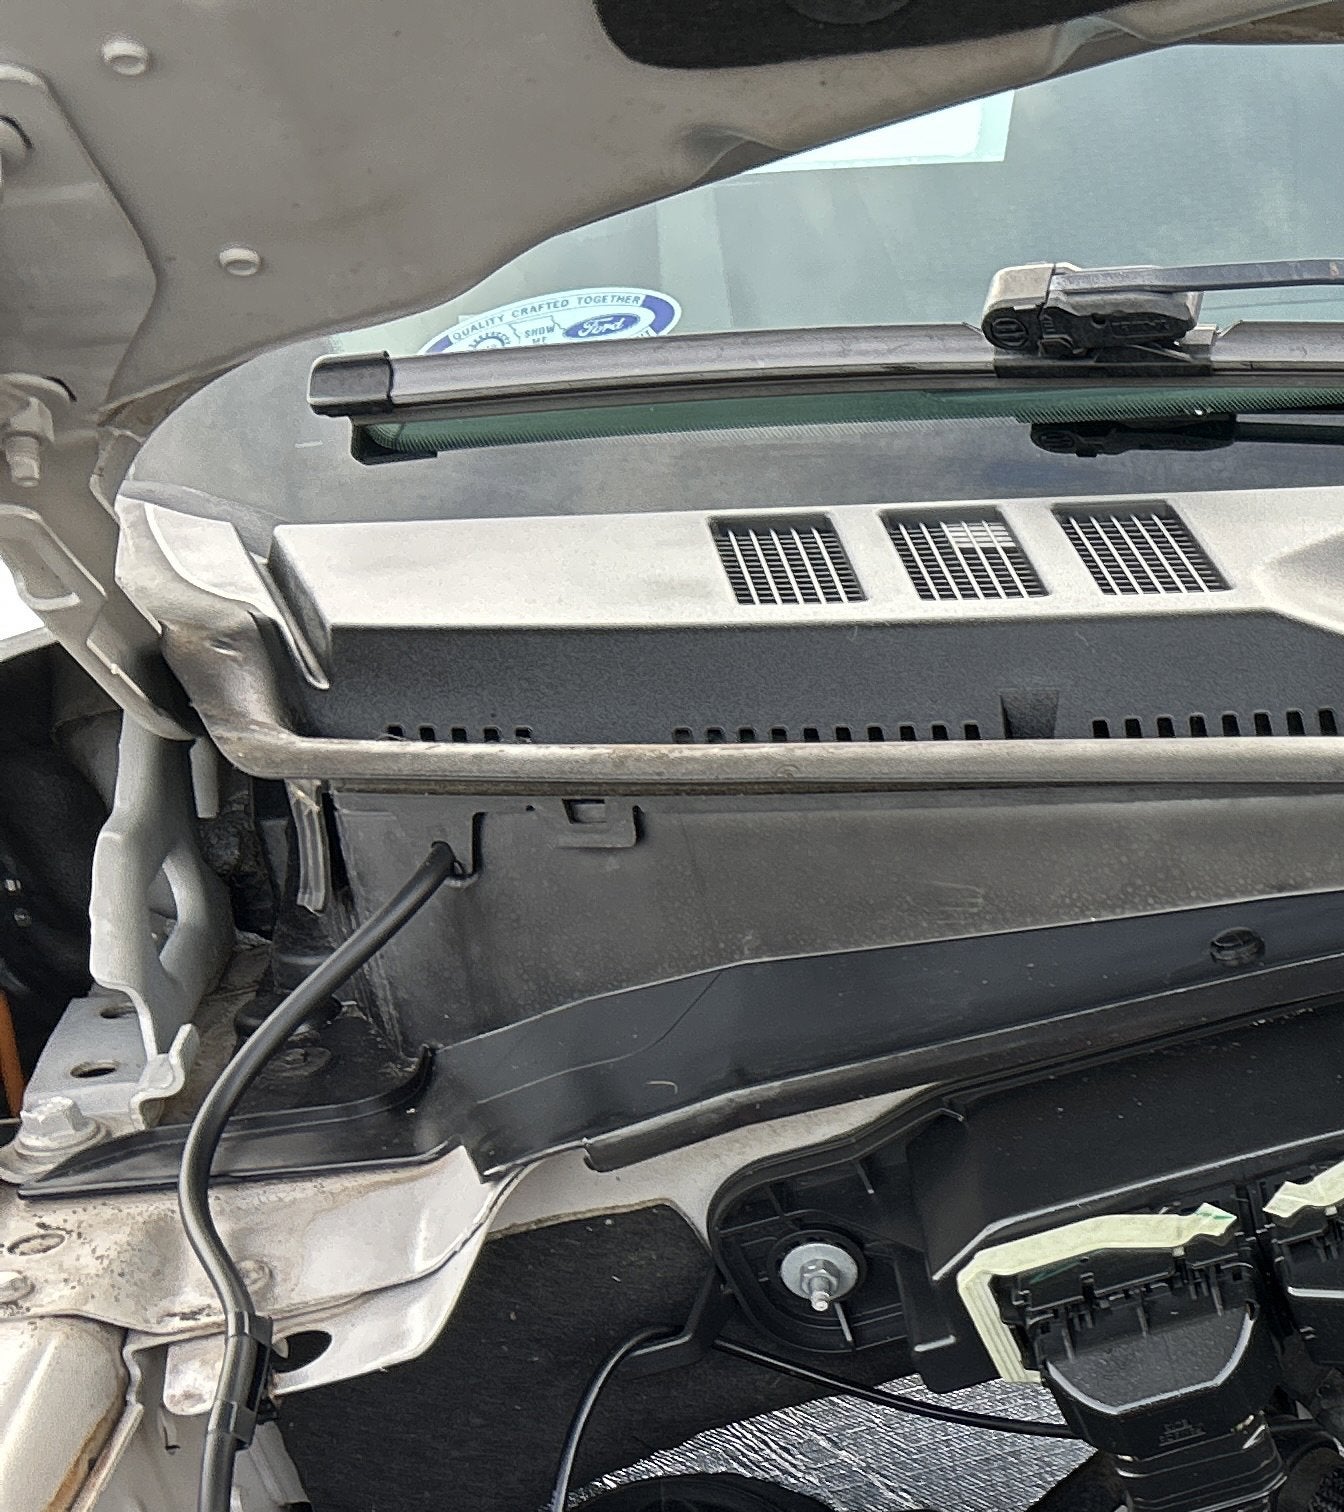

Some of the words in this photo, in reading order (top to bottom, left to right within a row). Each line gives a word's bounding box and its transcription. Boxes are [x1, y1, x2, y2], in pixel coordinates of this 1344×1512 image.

[452, 314, 504, 340] QUALITY
[511, 299, 569, 318] CRAFTED
[577, 295, 641, 306] TOGETHER
[578, 317, 625, 338] Ford
[524, 325, 556, 339] SHOW
